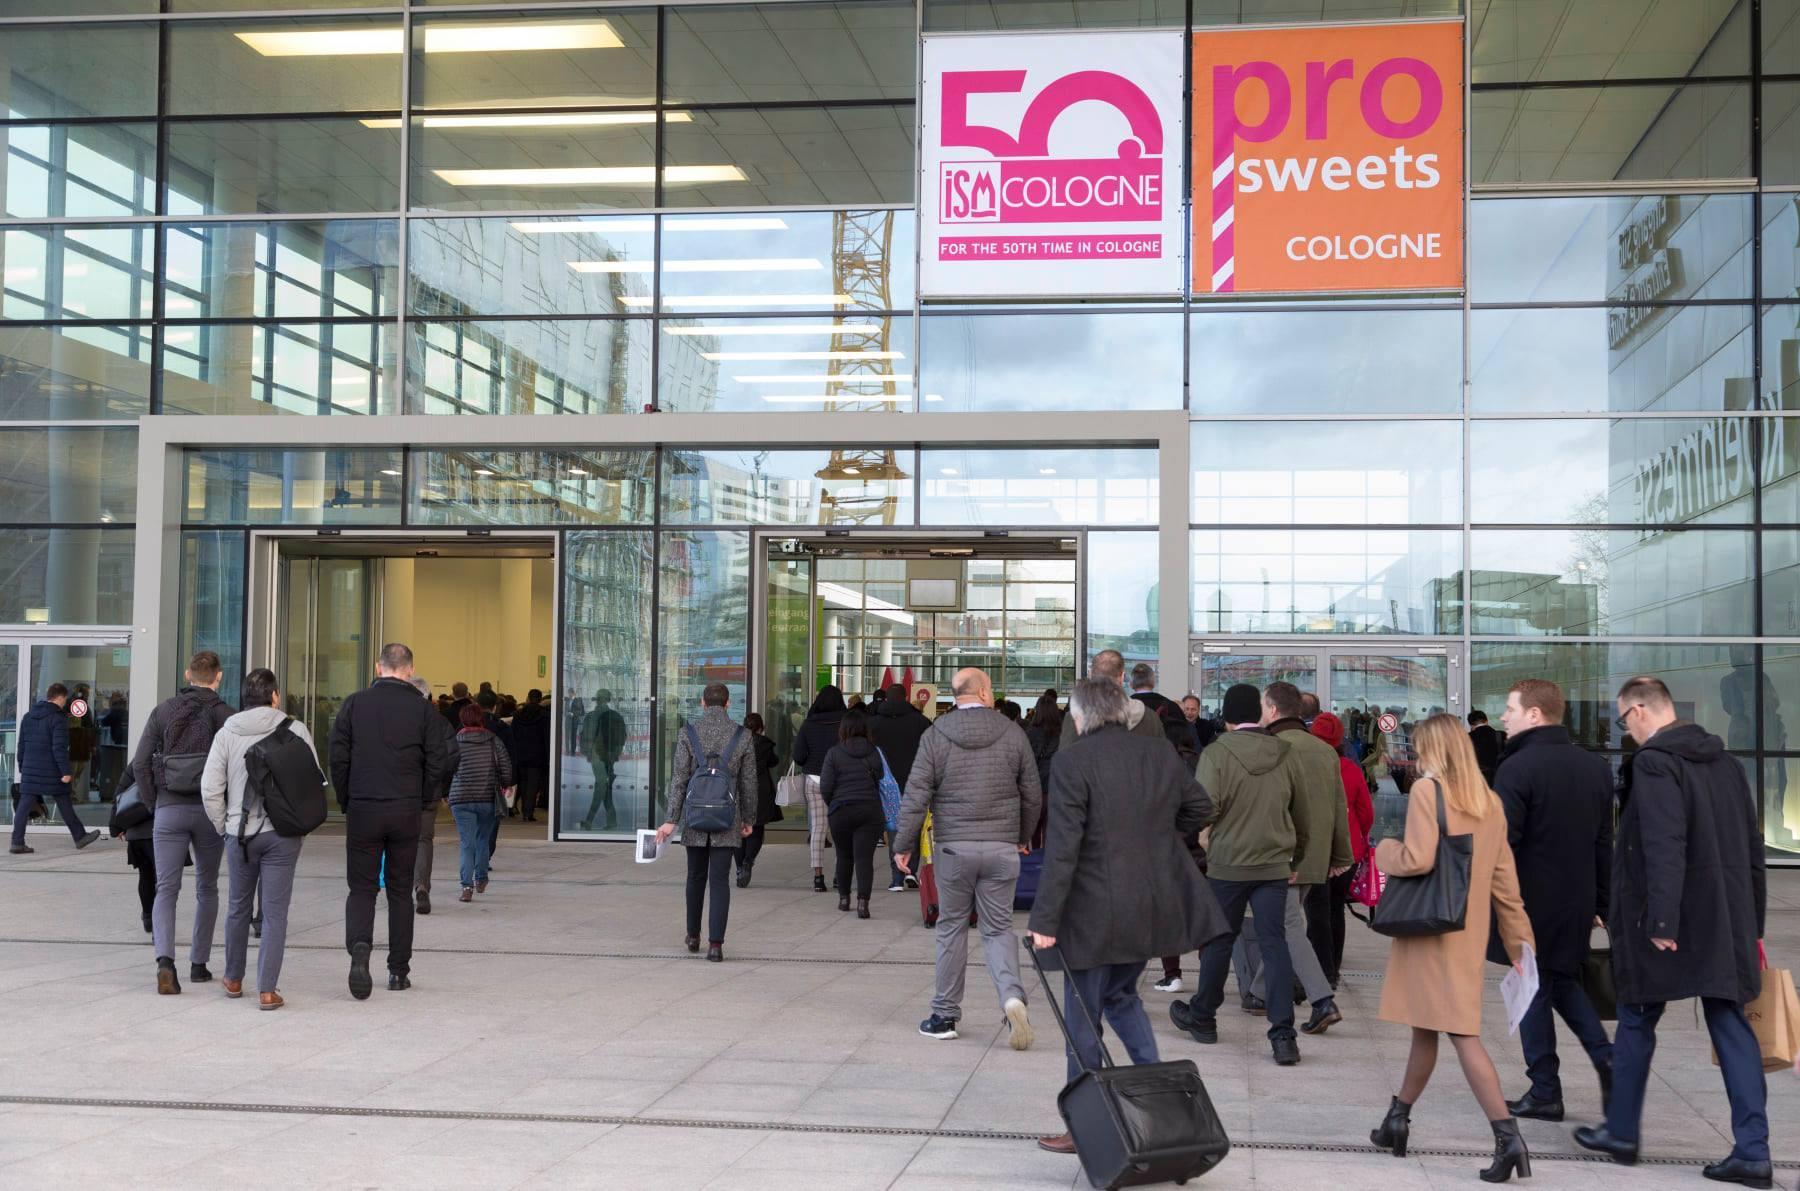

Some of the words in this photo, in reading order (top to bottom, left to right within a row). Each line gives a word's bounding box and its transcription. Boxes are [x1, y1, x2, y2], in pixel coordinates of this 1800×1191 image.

[941, 70, 1163, 157] 50
[1238, 146, 1440, 193] sweets
[1002, 175, 1160, 208] COLOGNE
[940, 243, 967, 255] FOR
[971, 242, 998, 254] THE
[1002, 242, 1037, 254] 50TH
[1041, 241, 1073, 254] TIME
[1078, 241, 1092, 253] IN
[1096, 240, 1160, 253] COLOGNE
[1286, 232, 1441, 261] COLOGNE
